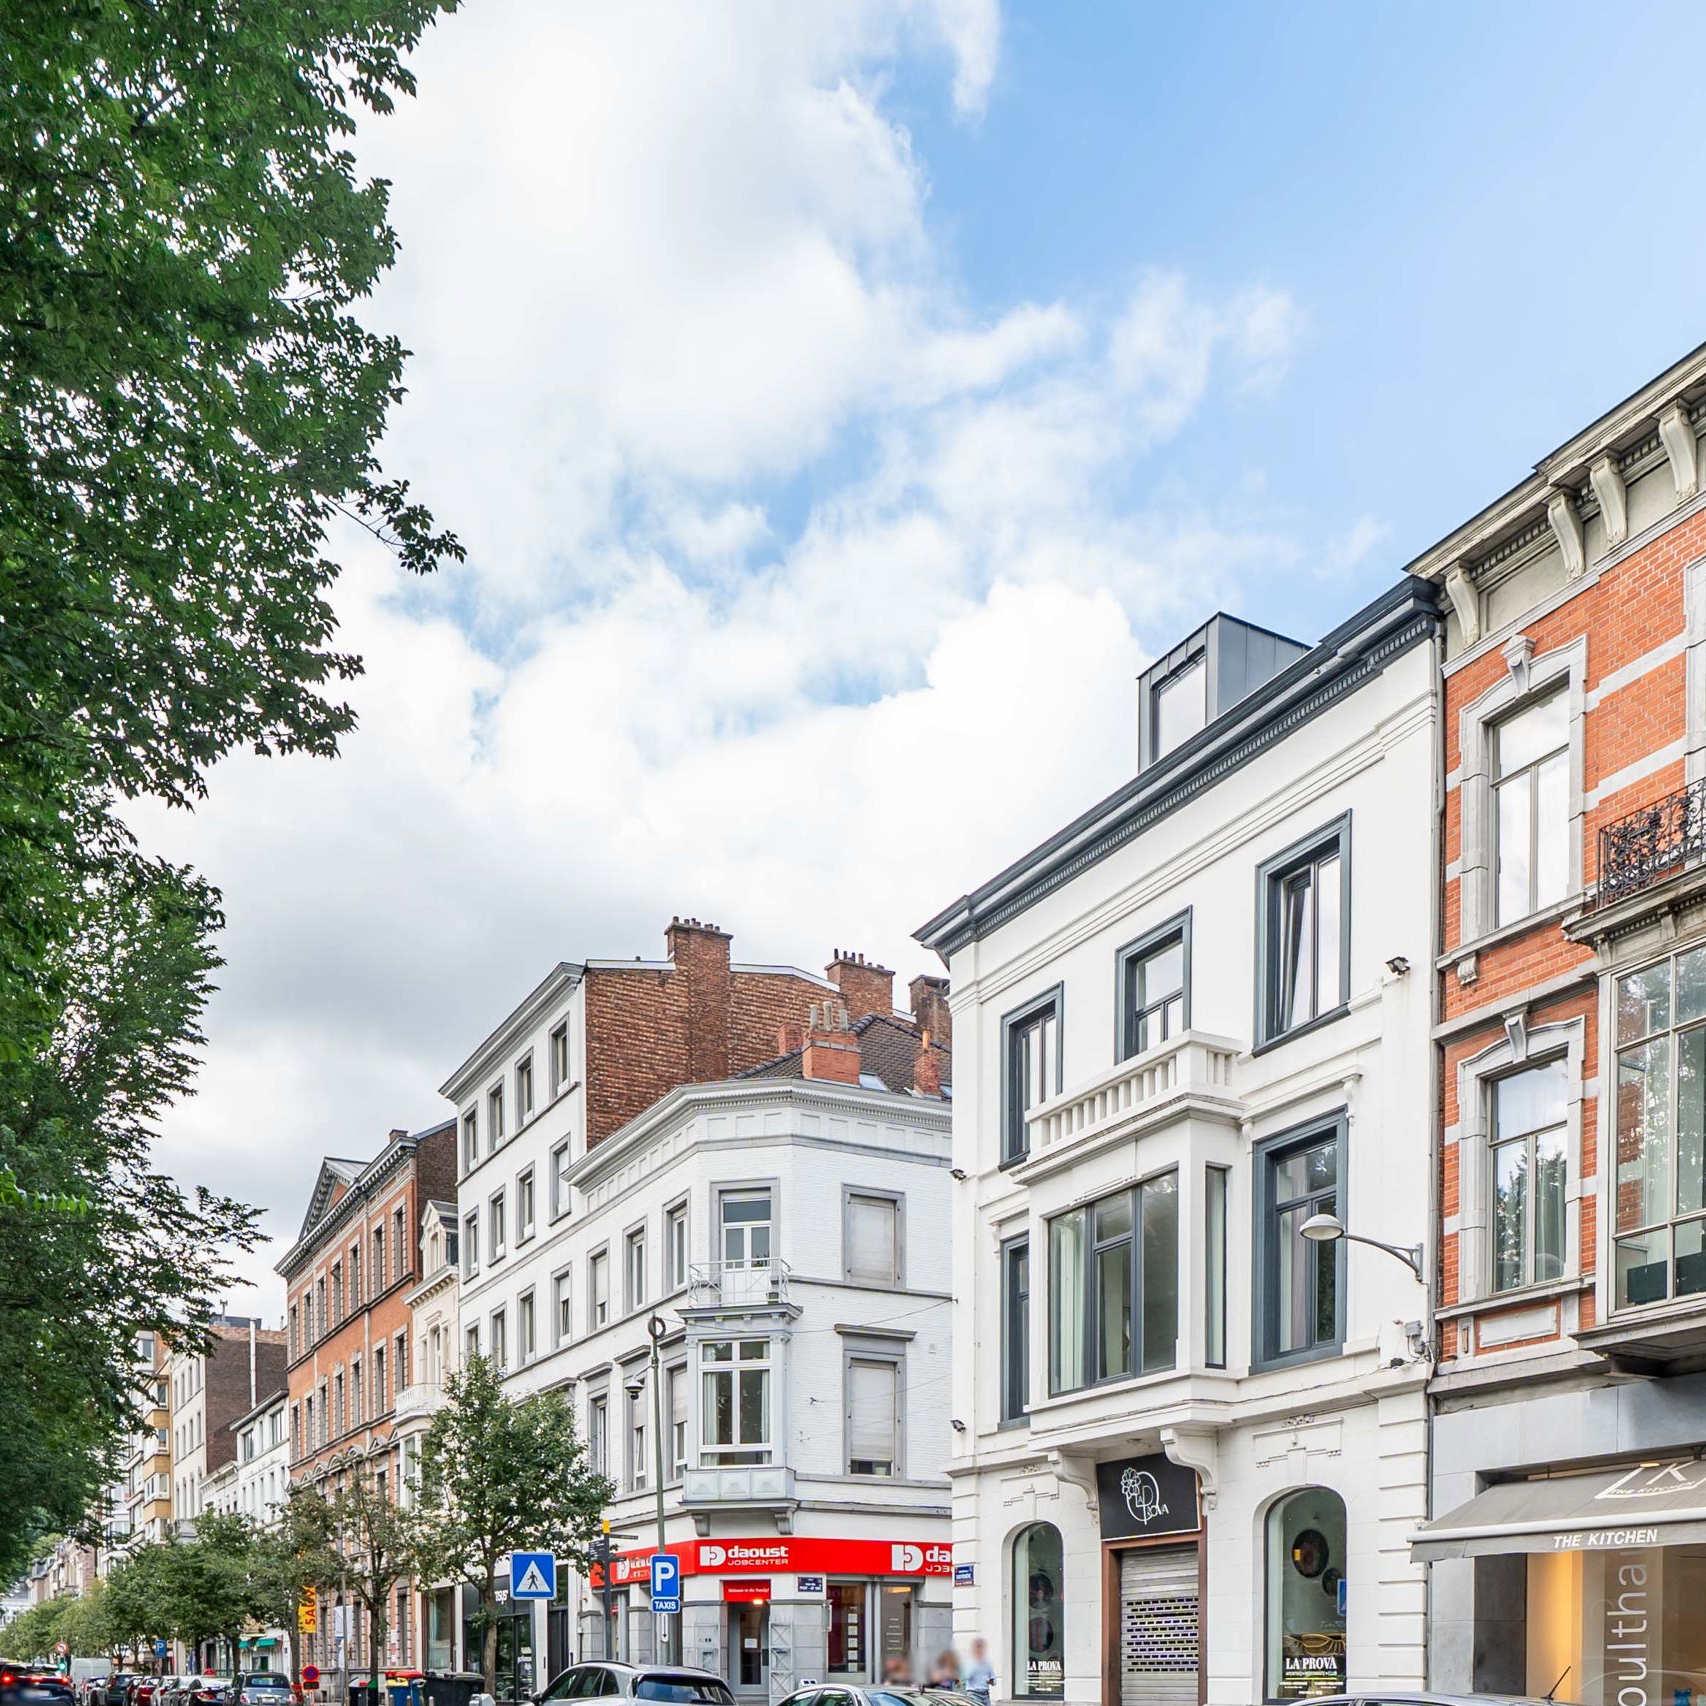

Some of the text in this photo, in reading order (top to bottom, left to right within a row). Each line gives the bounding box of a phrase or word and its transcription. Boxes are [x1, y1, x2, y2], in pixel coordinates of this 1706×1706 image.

[1553, 1529, 1658, 1549] THE KITCHEN
[728, 1545, 789, 1558] daoust
[925, 1545, 953, 1562] da
[655, 1561, 675, 1592] P
[655, 1601, 676, 1610] TAXIS
[1285, 1657, 1300, 1670] LA
